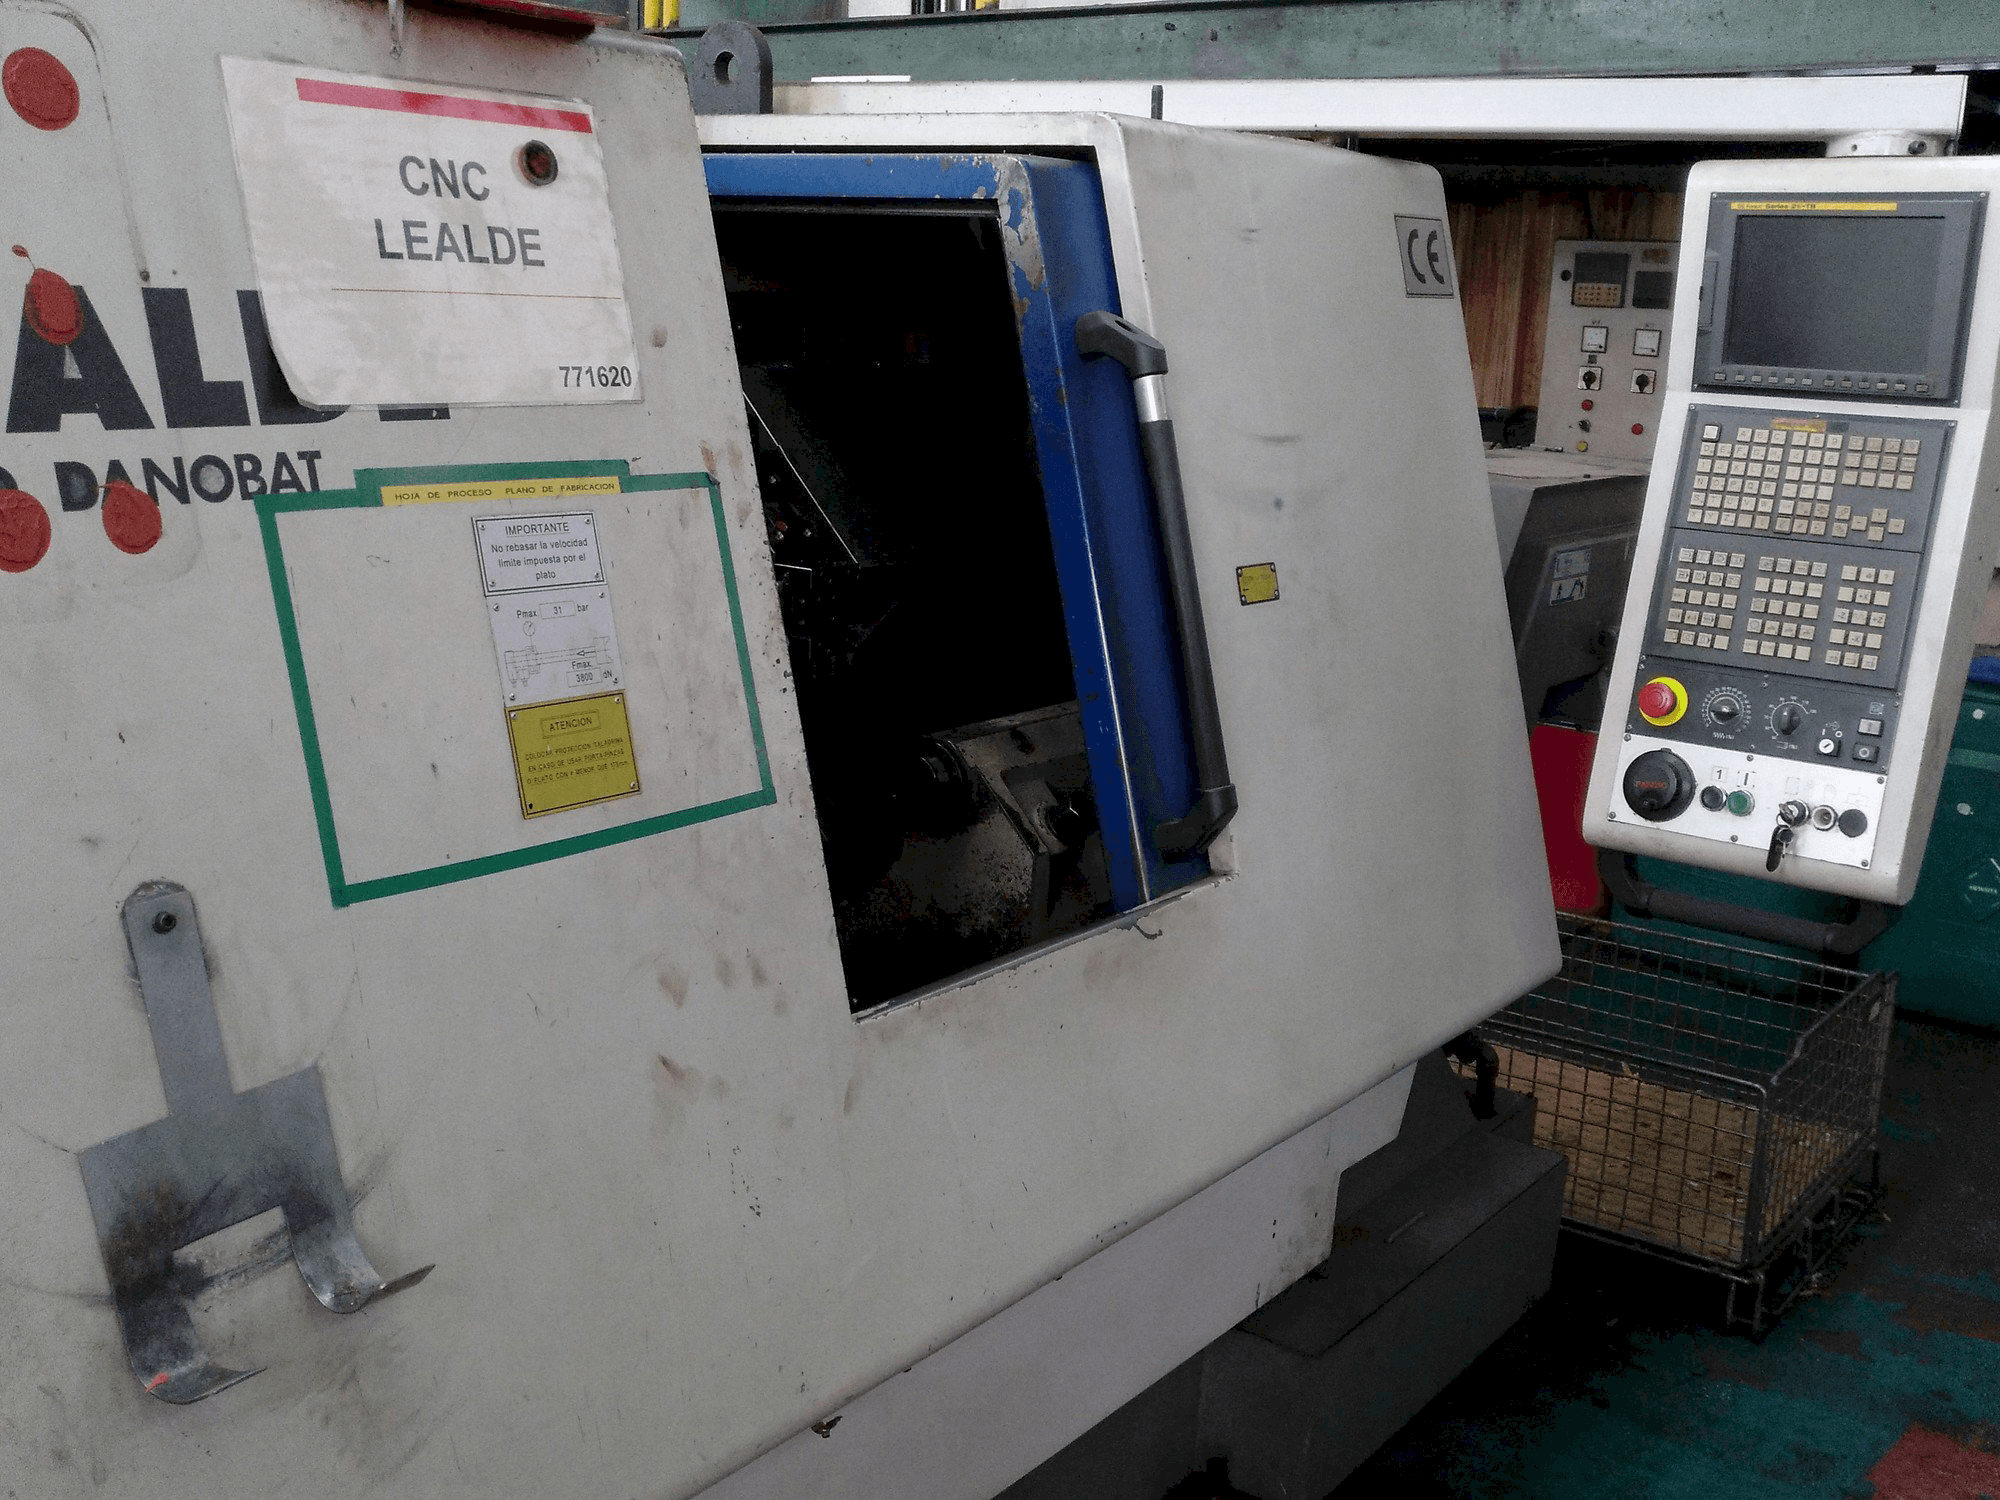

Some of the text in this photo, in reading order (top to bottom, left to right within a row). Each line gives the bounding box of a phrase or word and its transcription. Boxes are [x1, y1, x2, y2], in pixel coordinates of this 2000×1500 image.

[399, 155, 490, 201] CNC
[374, 218, 546, 267] LEALDE
[1407, 228, 1445, 284] CE
[558, 365, 632, 388] 771620
[395, 483, 615, 500] HOJA DE PROCESO PLANO DE FABRICACION
[504, 522, 570, 536] IMPORTANTE
[490, 538, 588, 553] No rebasar la velocidad
[523, 555, 561, 567] impuesta
[563, 554, 576, 564] por
[578, 553, 586, 561] el
[535, 570, 556, 581] plato
[516, 609, 538, 618] Pmax
[577, 603, 589, 612] bar
[571, 660, 592, 670] Fmax
[549, 716, 592, 731] ATENCION
